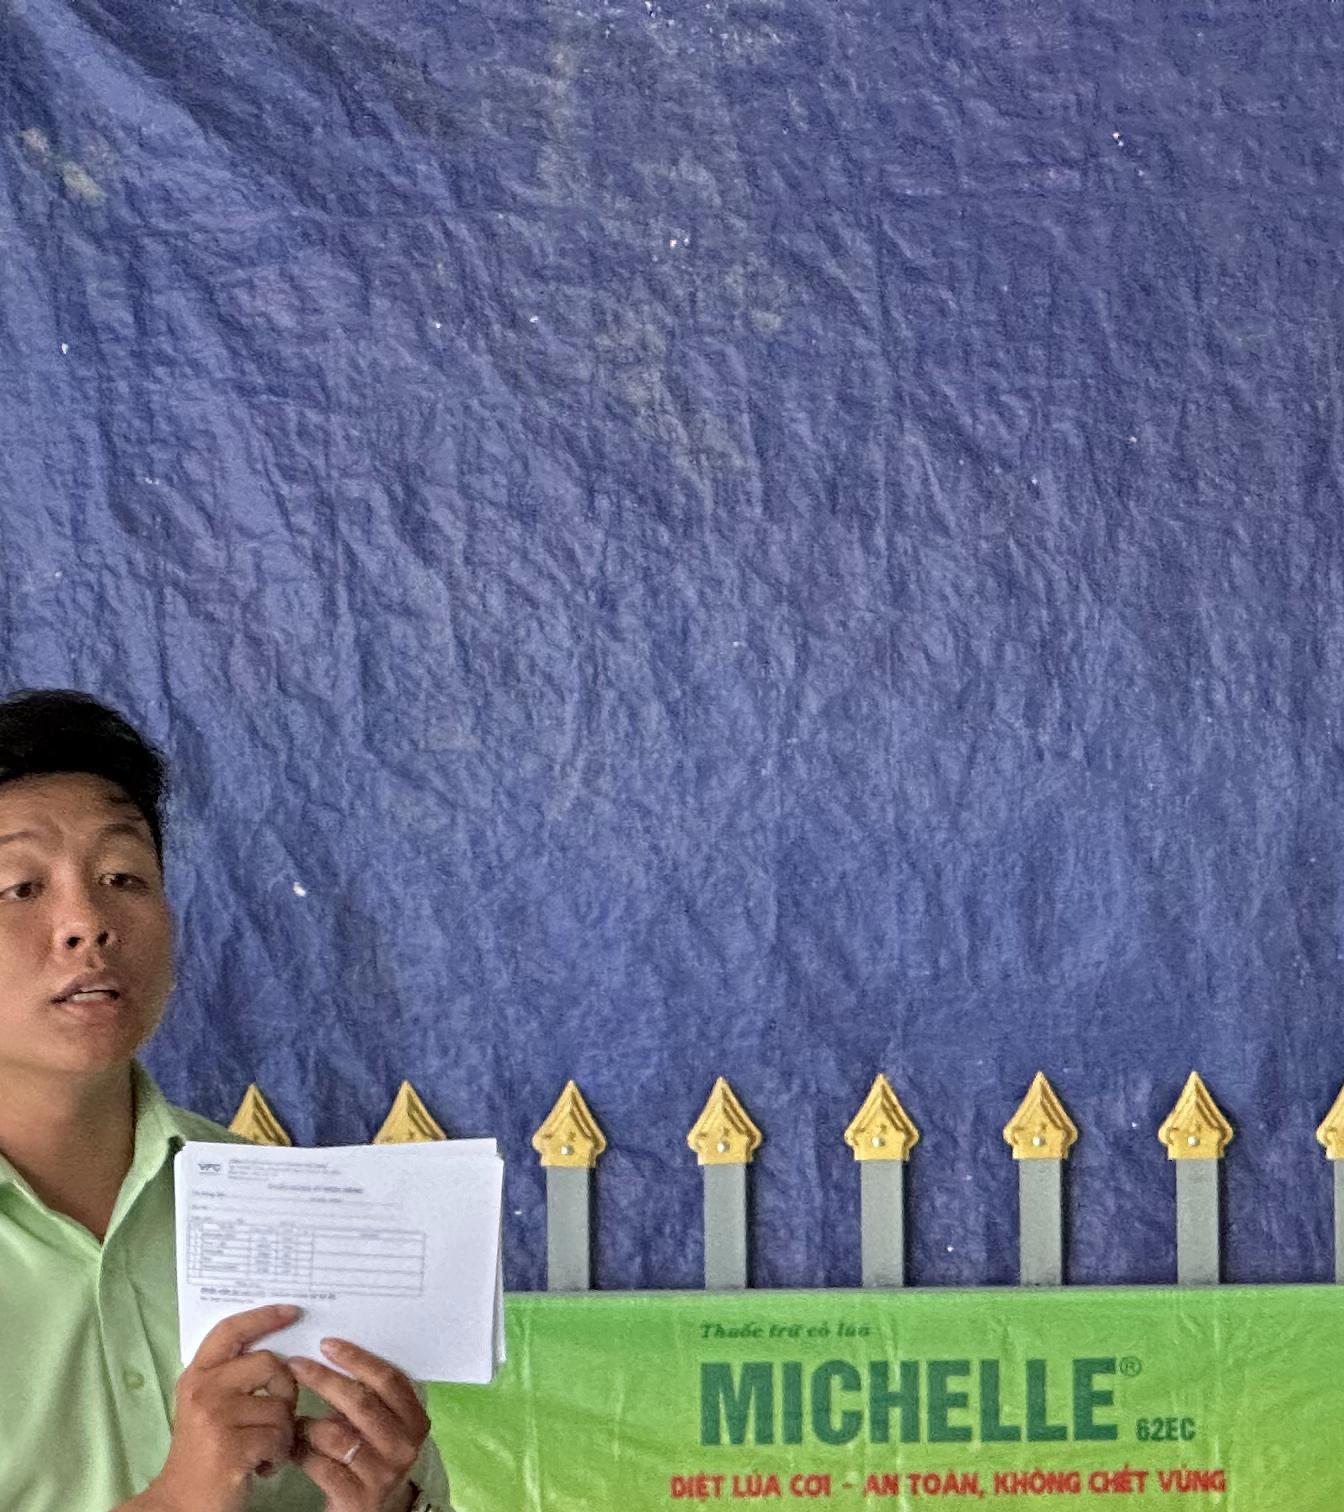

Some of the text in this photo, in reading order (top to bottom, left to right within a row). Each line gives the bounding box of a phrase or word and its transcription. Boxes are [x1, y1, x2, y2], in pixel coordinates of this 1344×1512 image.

[1136, 1417, 1196, 1442] 62EC
[671, 1471, 725, 1503] DIỆT
[864, 1473, 899, 1498] AN
[993, 1467, 1082, 1495] KHÔNG
[1088, 1461, 1149, 1494] CHẾT
